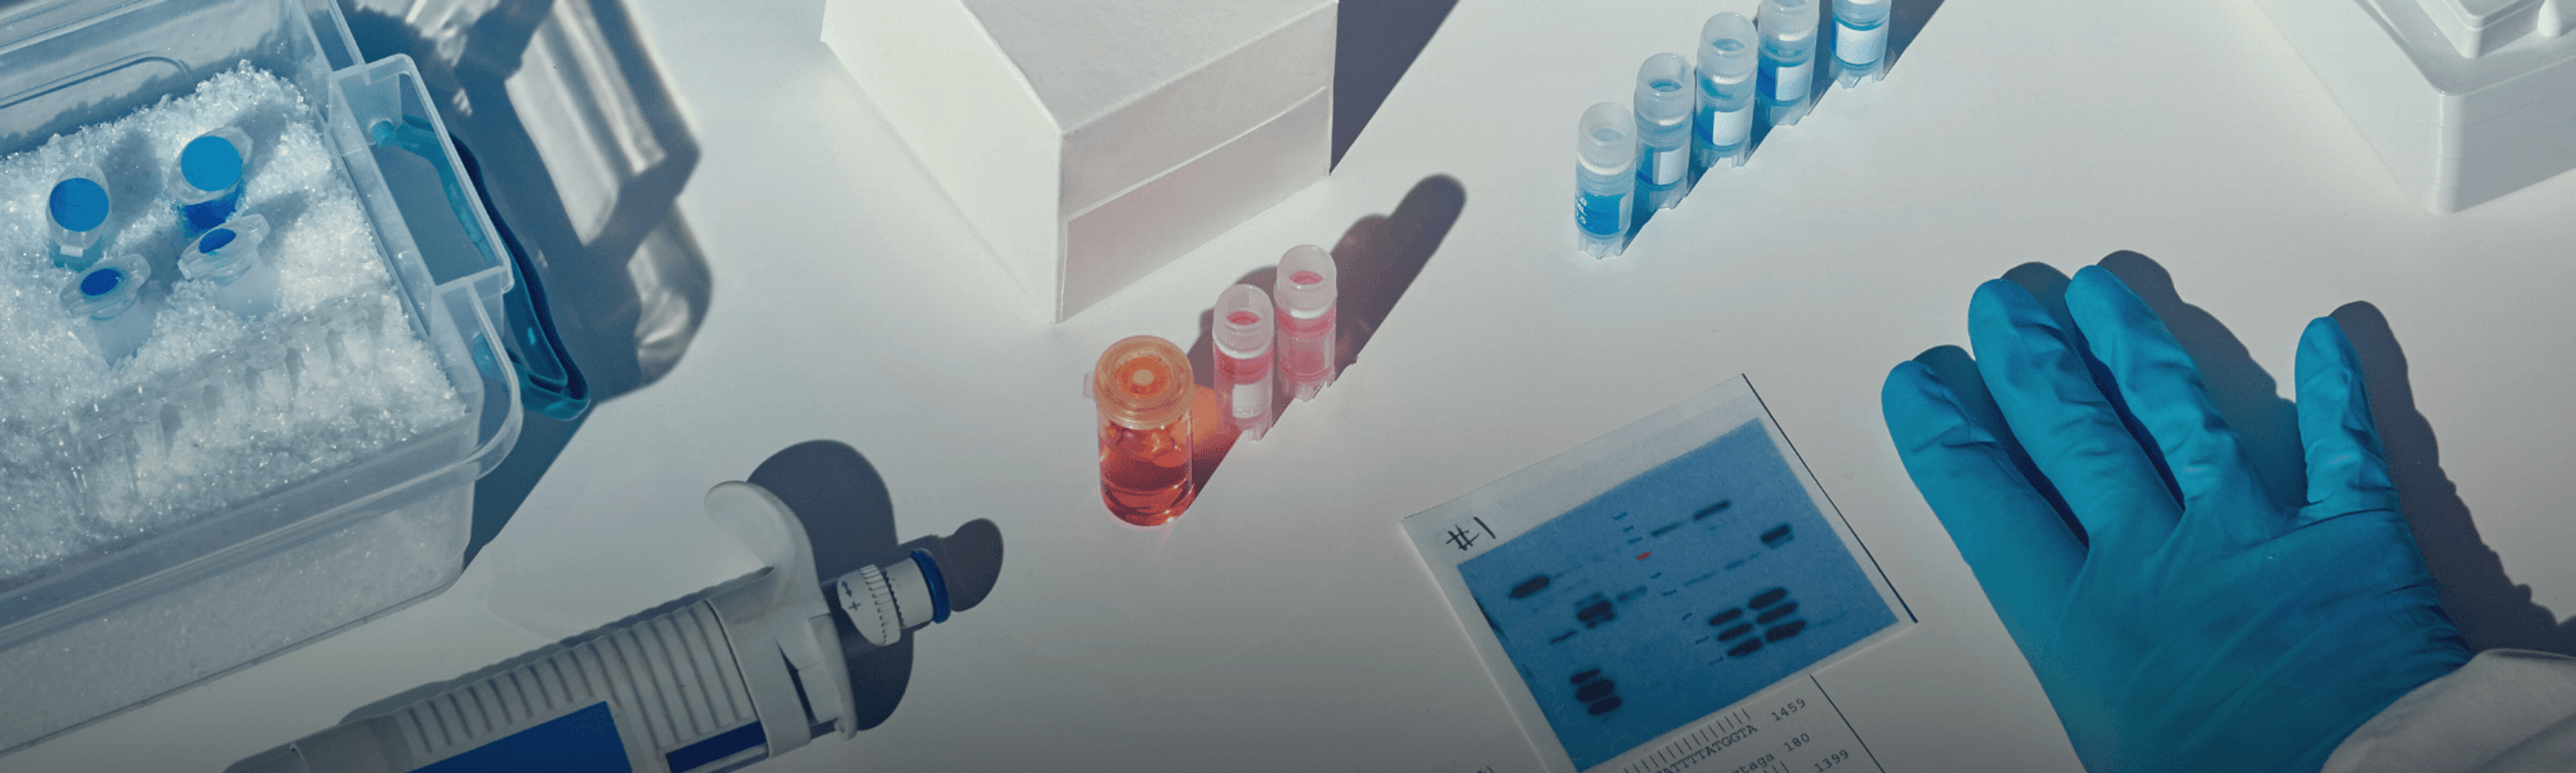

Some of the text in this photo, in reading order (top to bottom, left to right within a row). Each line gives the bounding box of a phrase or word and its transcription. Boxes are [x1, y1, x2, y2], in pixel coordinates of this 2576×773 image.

[1446, 516, 1496, 551] #1
[1656, 698, 1806, 773] ATTTTATGGTA 1459
[1784, 733, 1810, 752] 180
[1814, 749, 1849, 772] 1399
